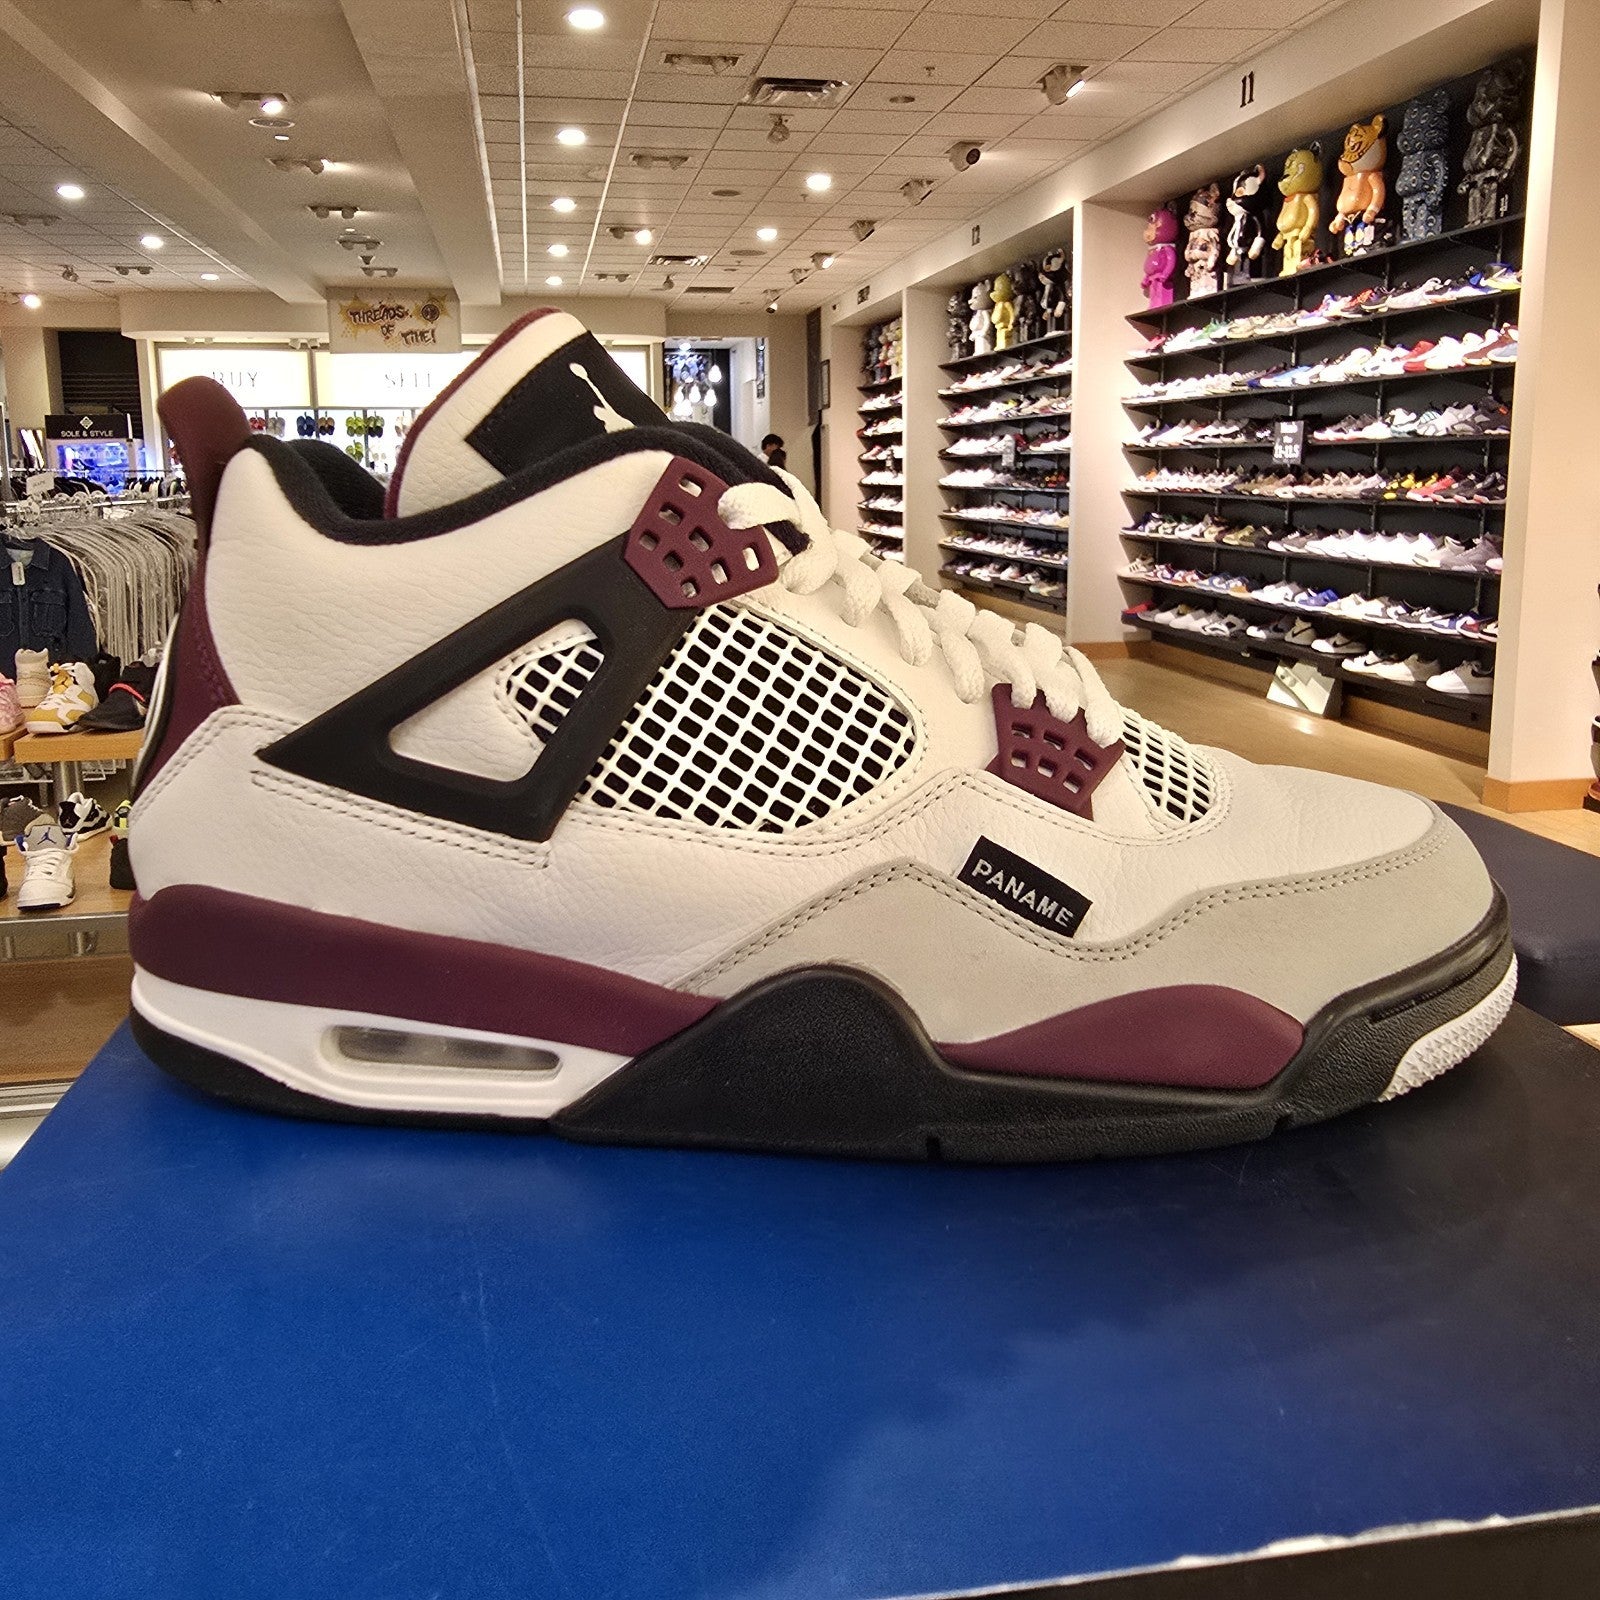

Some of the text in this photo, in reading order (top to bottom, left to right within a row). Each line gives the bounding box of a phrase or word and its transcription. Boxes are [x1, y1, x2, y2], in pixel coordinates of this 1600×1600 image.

[350, 304, 405, 323] THREADS
[381, 323, 395, 337] OF
[60, 430, 80, 438] SOLE
[90, 430, 113, 438] STYLE
[971, 858, 1074, 928] PANAME
